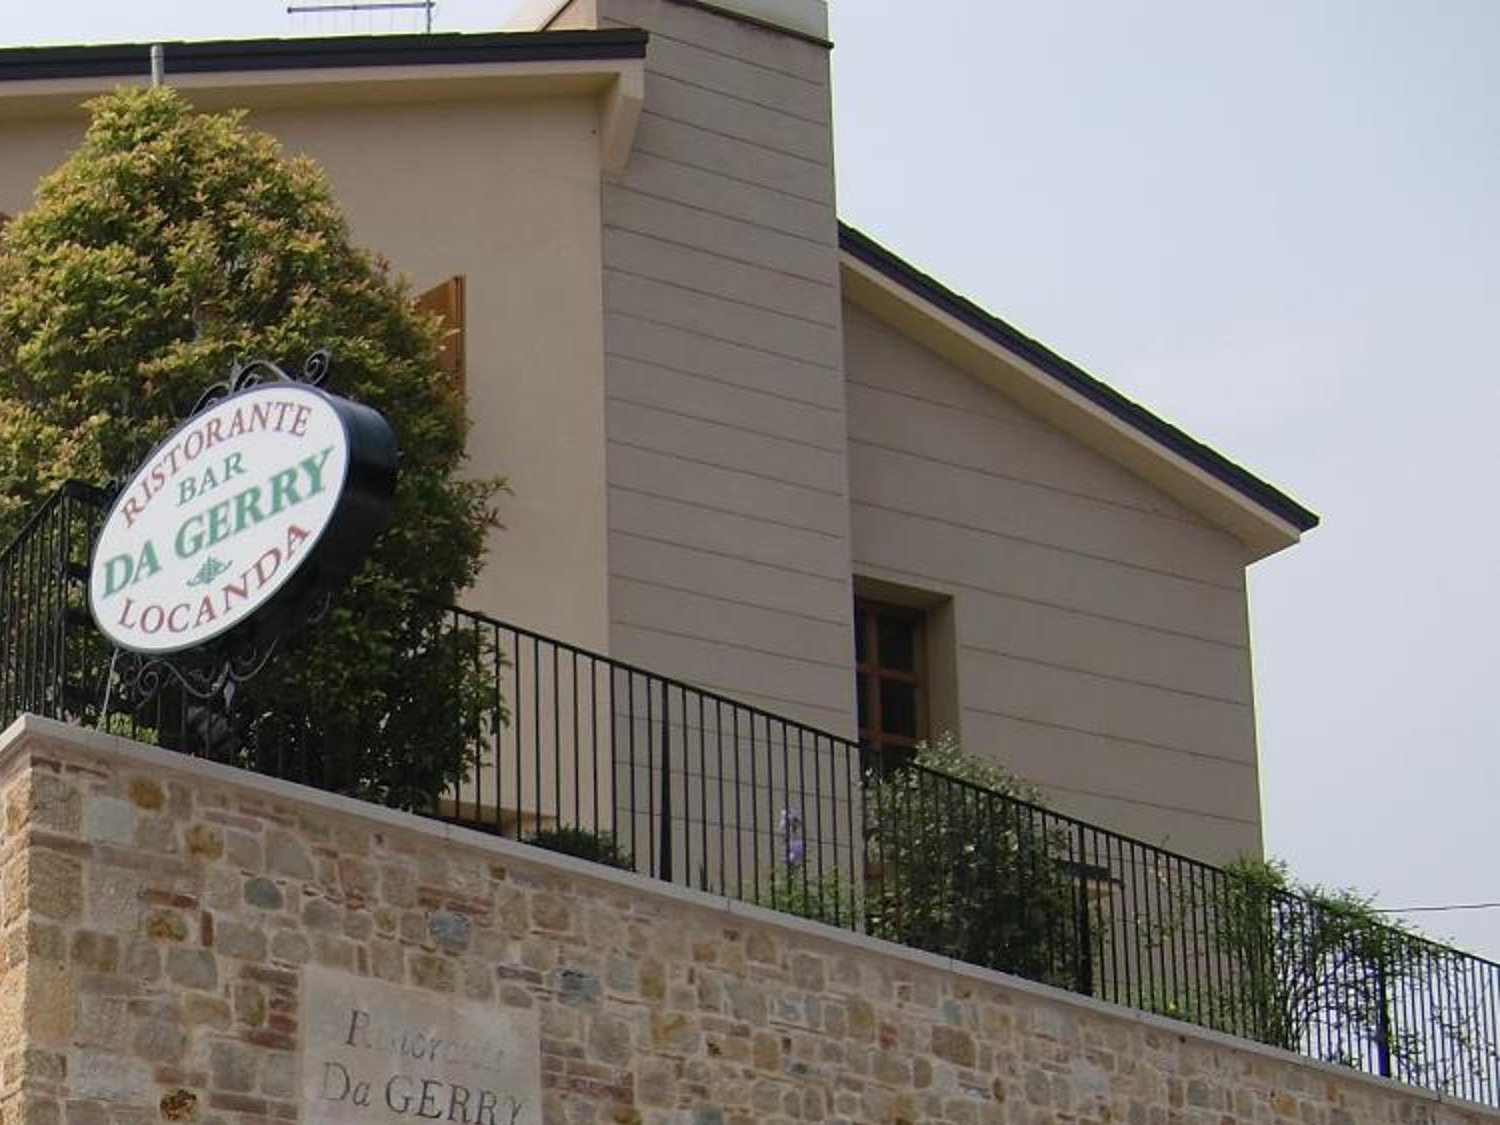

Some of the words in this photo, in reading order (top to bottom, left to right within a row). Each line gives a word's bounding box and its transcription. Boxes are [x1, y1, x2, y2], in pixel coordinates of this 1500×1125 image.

[119, 400, 312, 528] RISTORANTE
[177, 451, 248, 506] BAR
[102, 538, 163, 600] DA
[173, 445, 335, 560] GERRY
[118, 522, 311, 634] LOCANDA
[319, 1060, 371, 1108] Da
